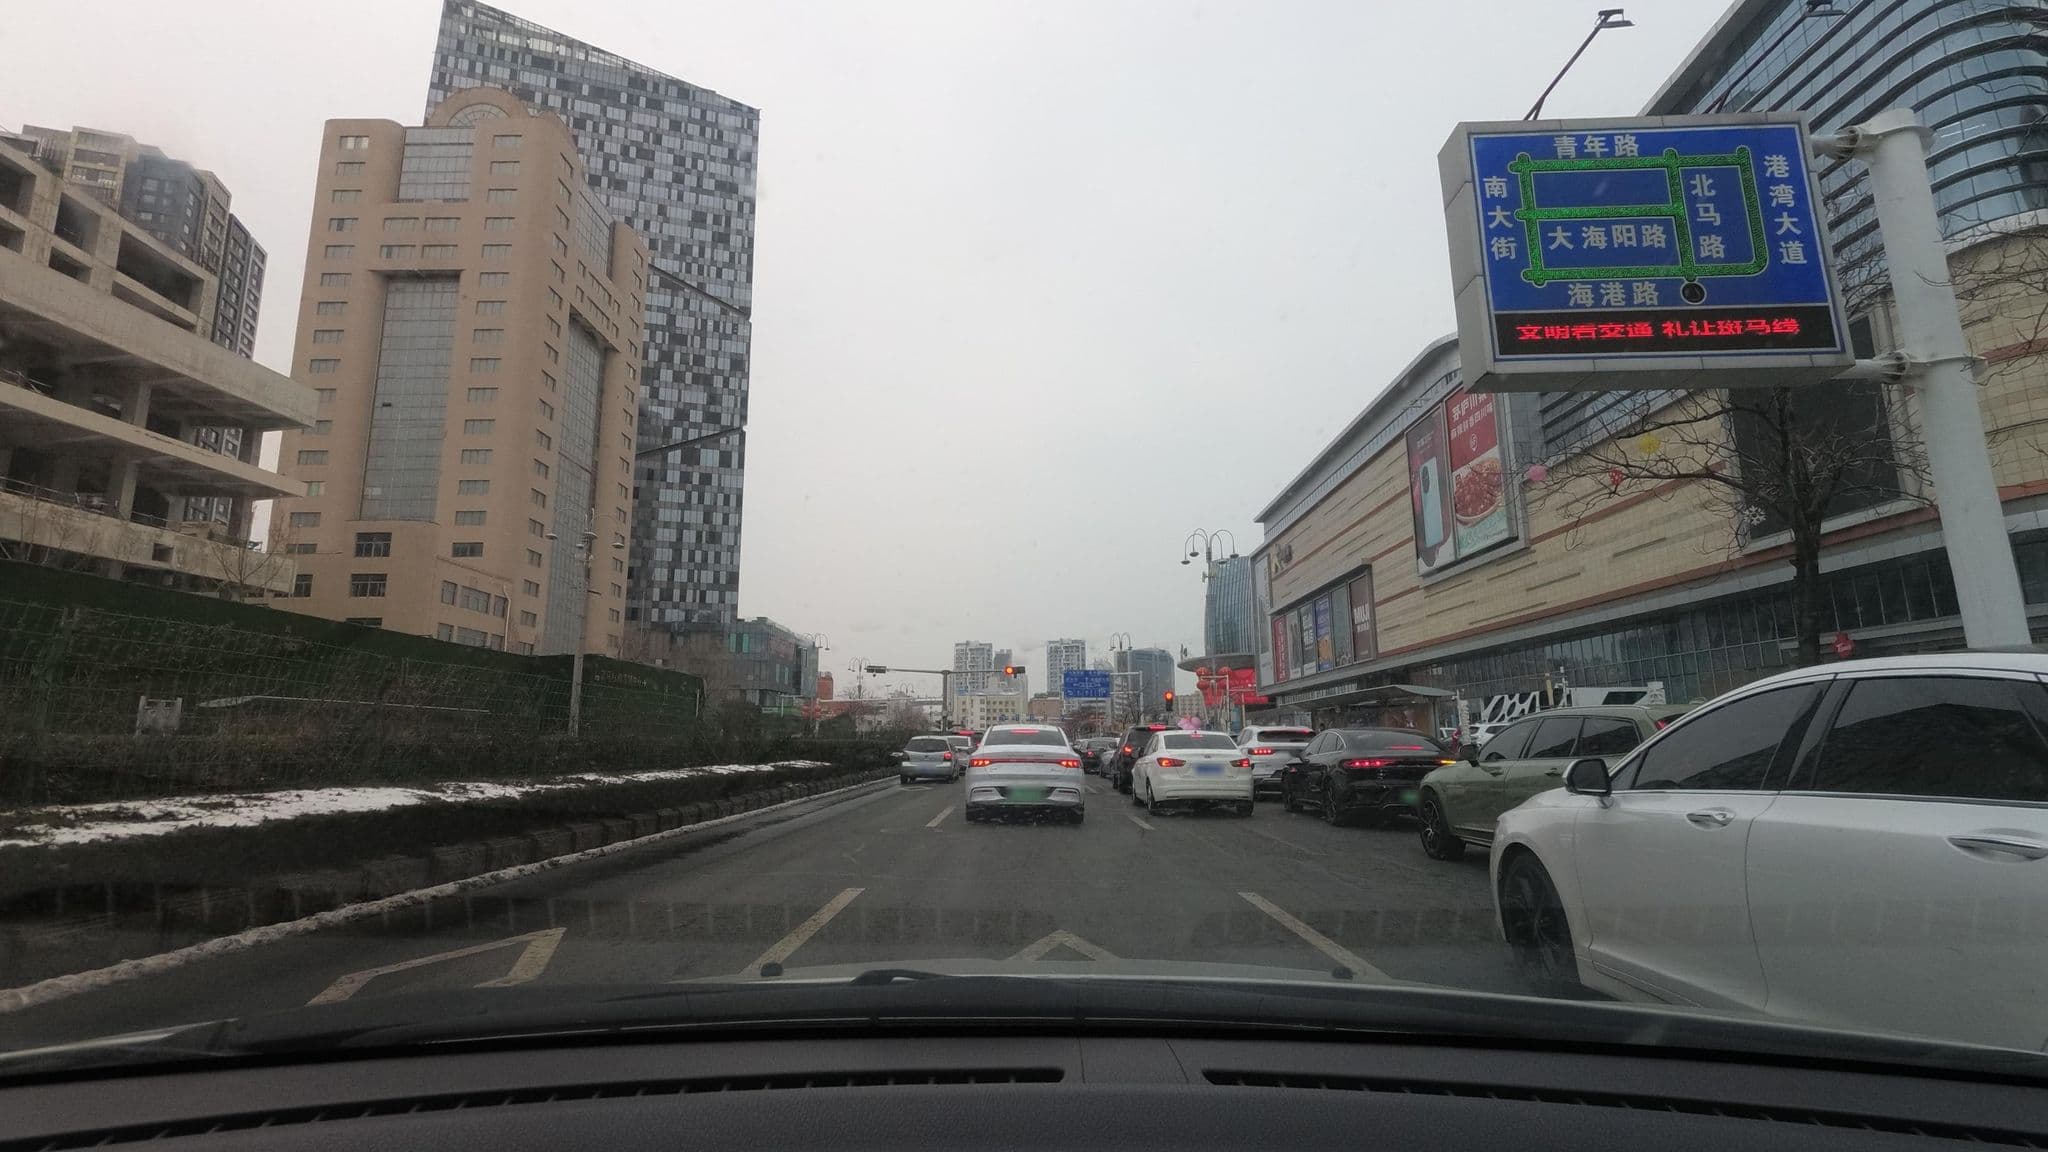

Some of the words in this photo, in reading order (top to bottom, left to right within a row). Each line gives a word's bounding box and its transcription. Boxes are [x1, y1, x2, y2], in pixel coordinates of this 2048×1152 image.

[1553, 134, 1639, 159] 青年路
[1483, 176, 1517, 261] 南大街
[1690, 174, 1726, 259] 北马路
[1764, 154, 1808, 265] 港湾大道
[1547, 223, 1667, 251] 大海阳路
[1568, 282, 1660, 307] 海港路
[1662, 317, 1800, 337] 礼让斑马线
